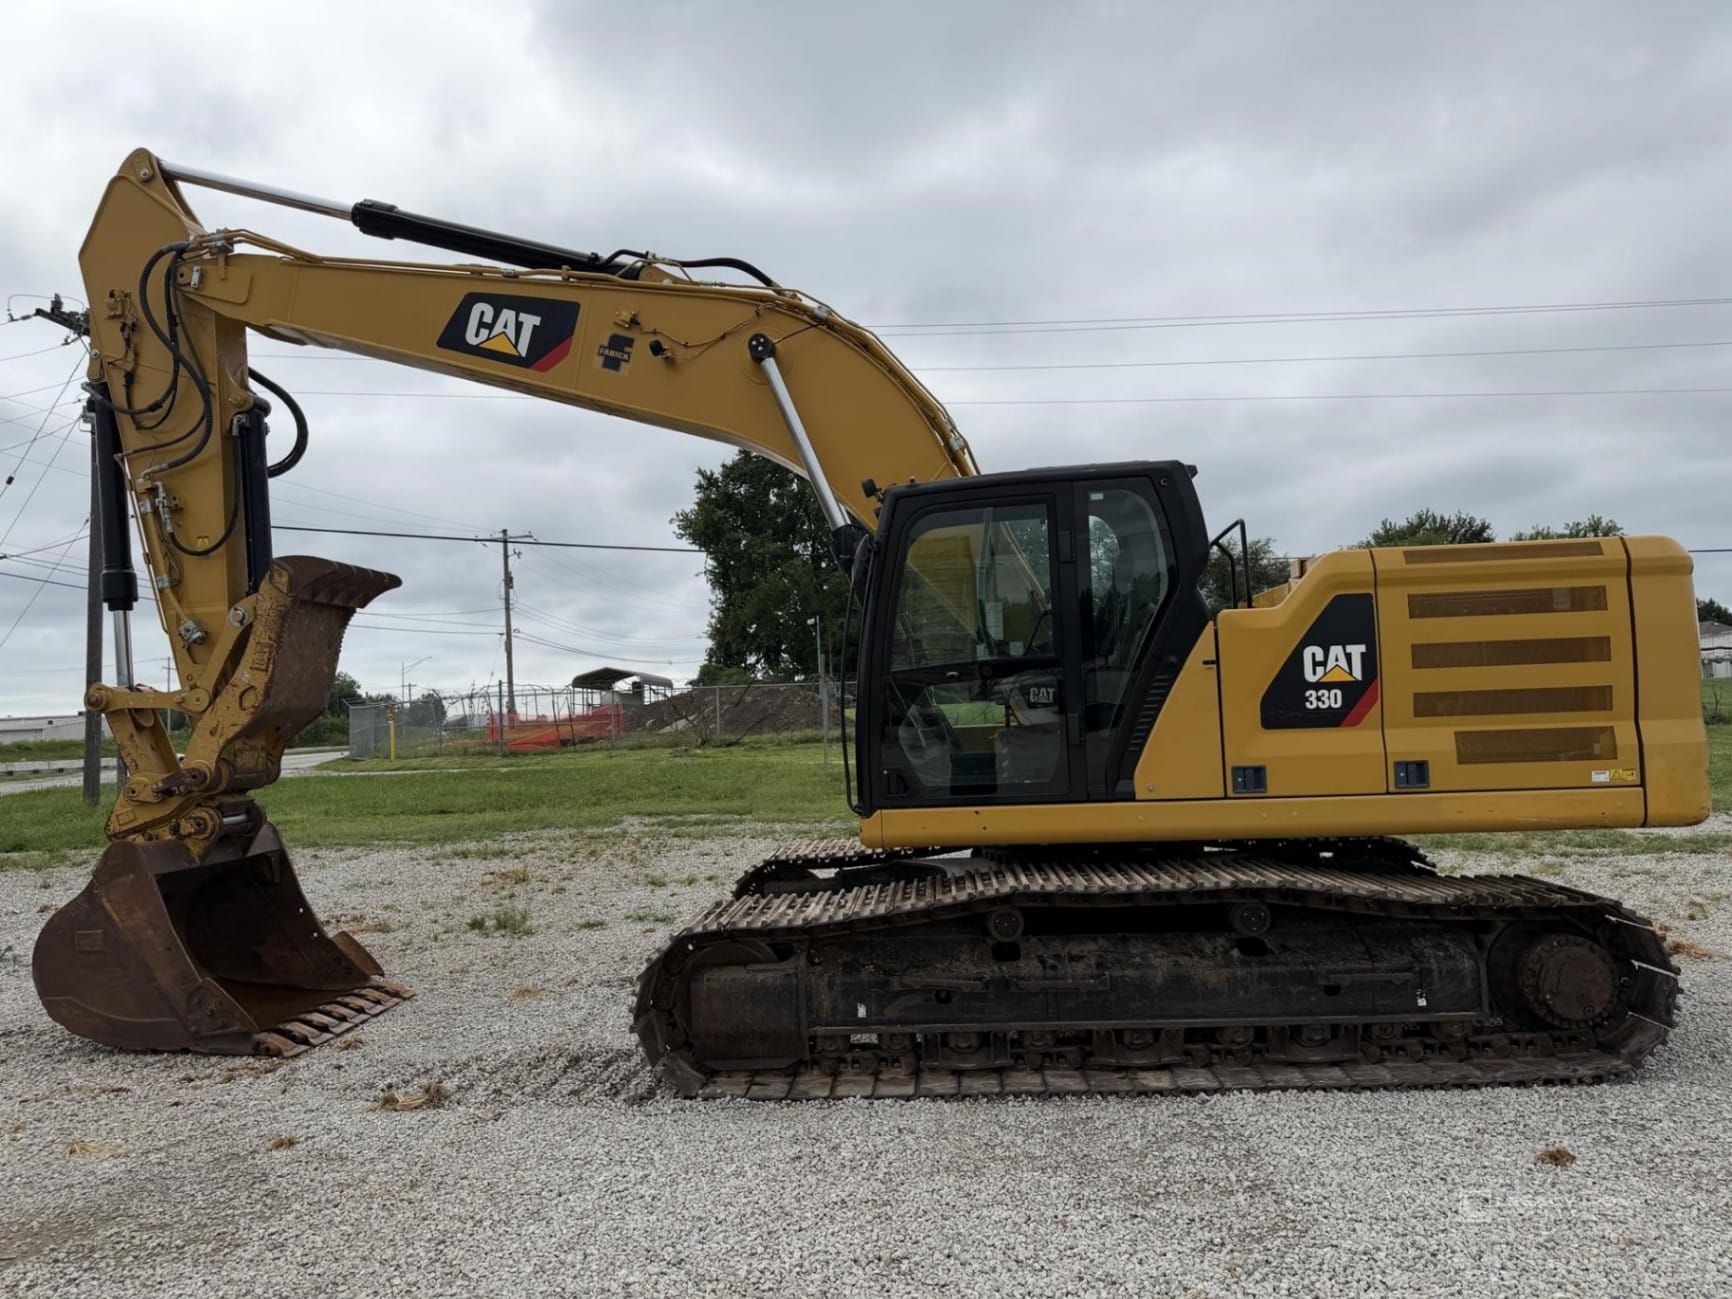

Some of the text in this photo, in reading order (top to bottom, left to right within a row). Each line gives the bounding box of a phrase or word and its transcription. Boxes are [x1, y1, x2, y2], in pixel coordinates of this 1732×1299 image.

[465, 302, 541, 357] CAT
[1303, 644, 1366, 683] CAT
[1029, 687, 1056, 703] CAT
[1305, 689, 1342, 709] 330
